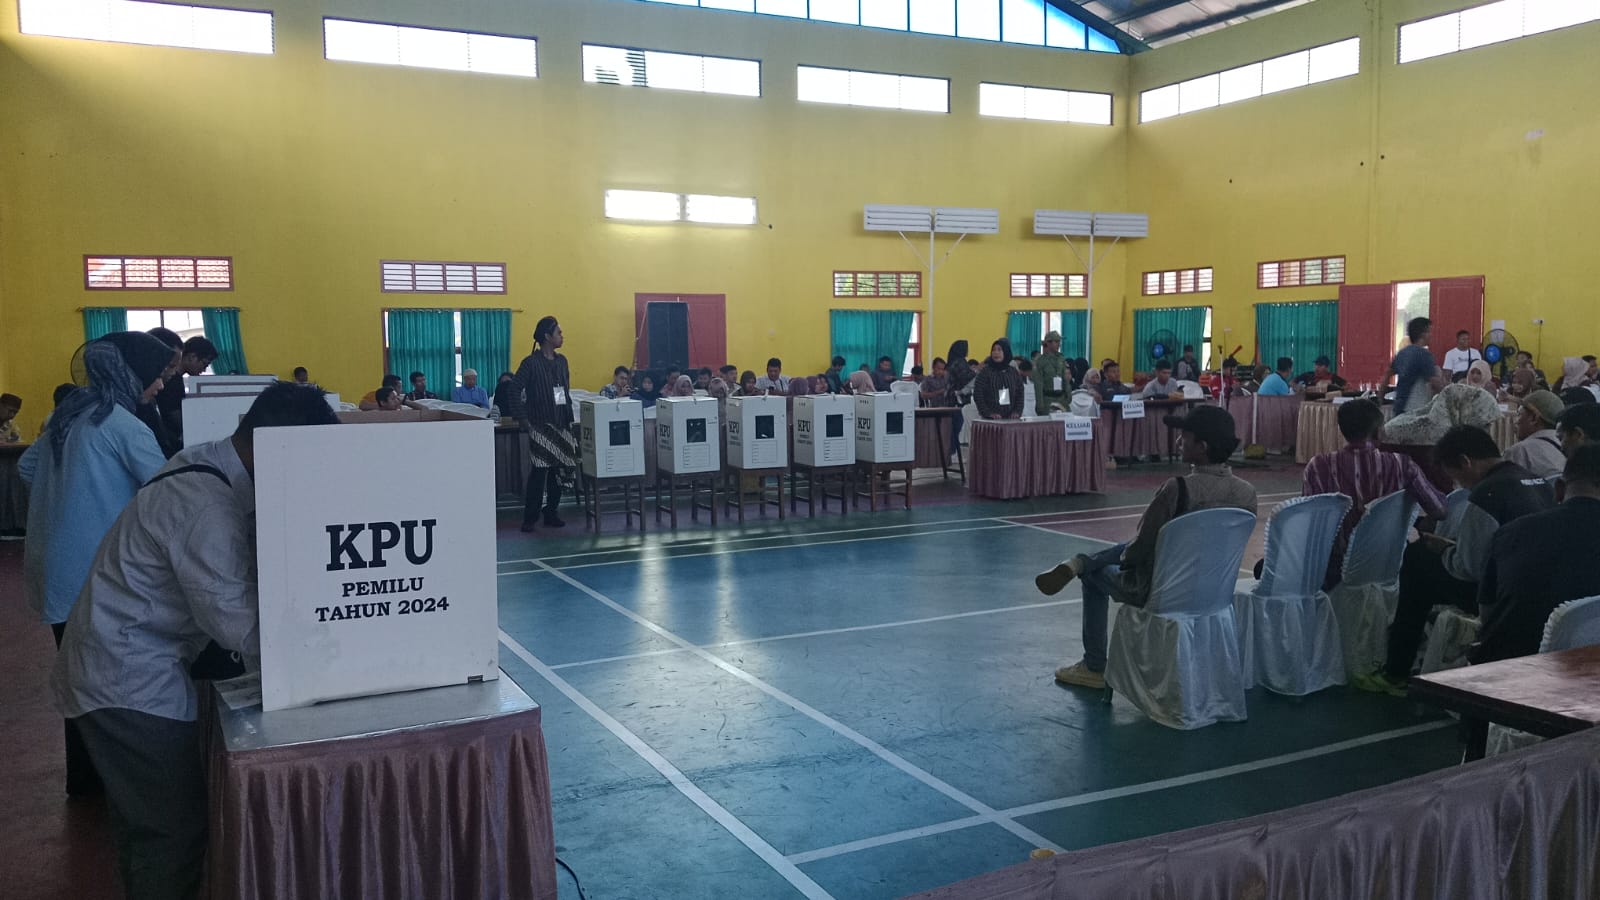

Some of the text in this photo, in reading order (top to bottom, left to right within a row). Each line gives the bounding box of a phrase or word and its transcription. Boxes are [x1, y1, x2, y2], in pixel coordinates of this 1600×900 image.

[797, 419, 811, 433] KPU
[857, 417, 871, 430] KPU
[325, 518, 437, 572] KPU
[341, 577, 425, 597] PEMILU
[314, 597, 450, 622] TAHUN 2024
